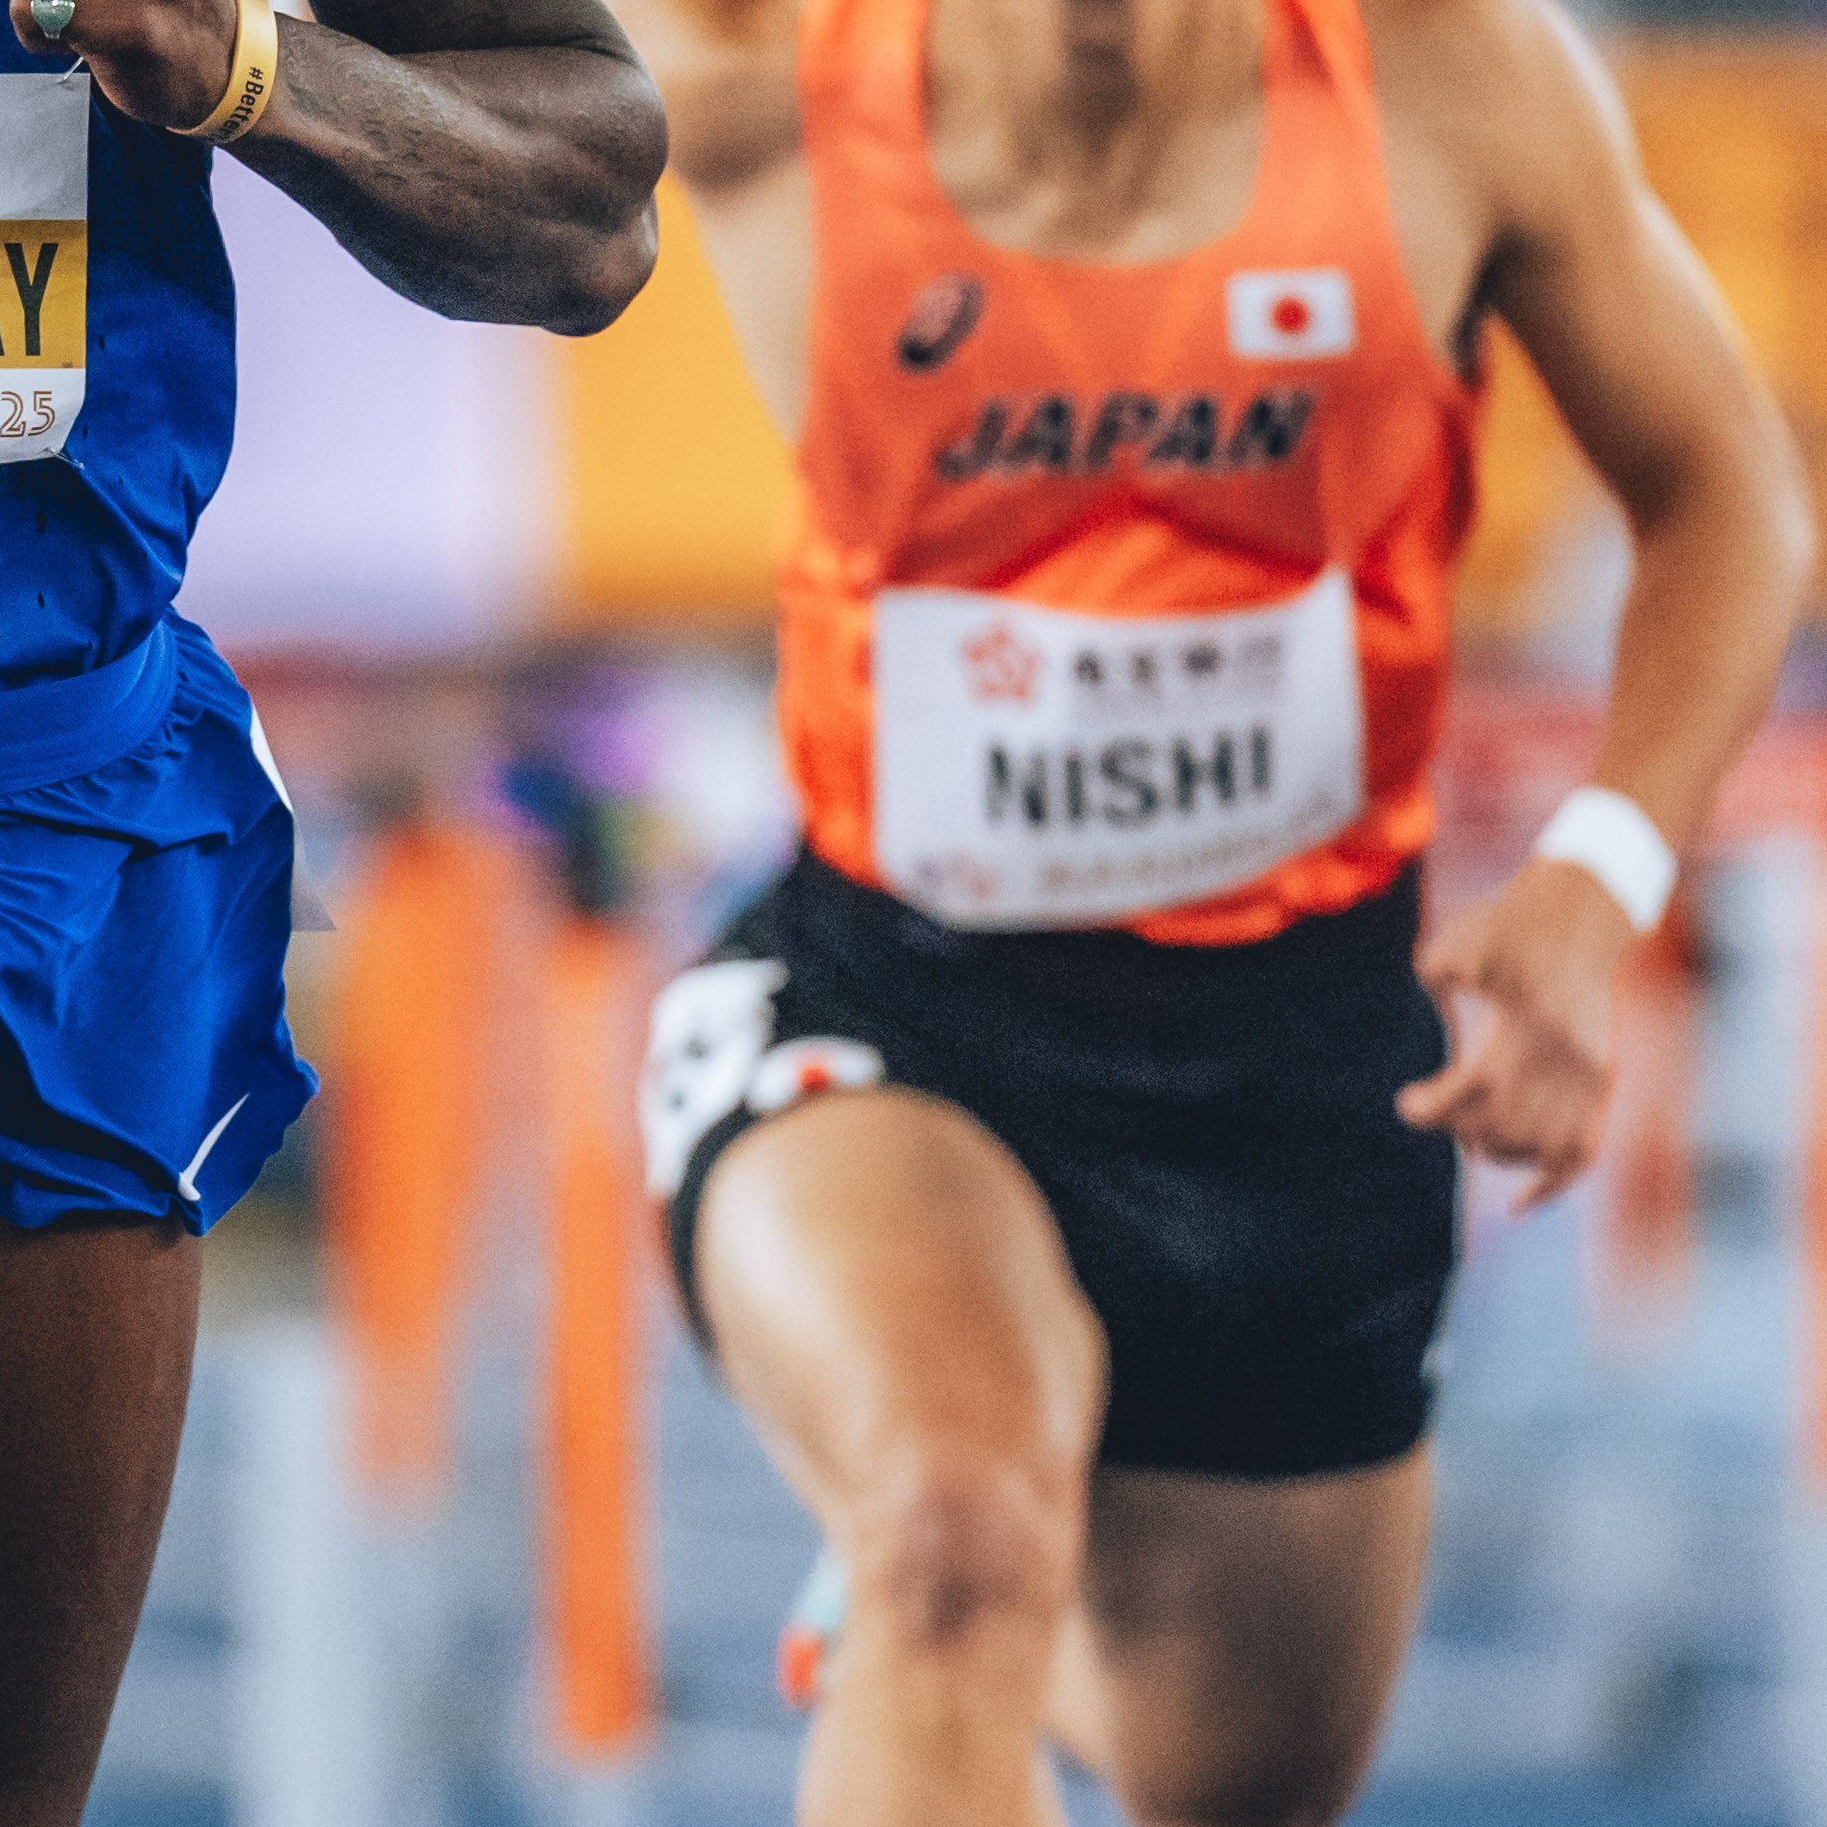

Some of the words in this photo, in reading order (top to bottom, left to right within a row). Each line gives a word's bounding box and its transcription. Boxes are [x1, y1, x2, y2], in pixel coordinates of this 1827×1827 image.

[0, 390, 56, 439] 25
[932, 387, 1320, 484] JAPAN
[981, 722, 1275, 833] NISHI
